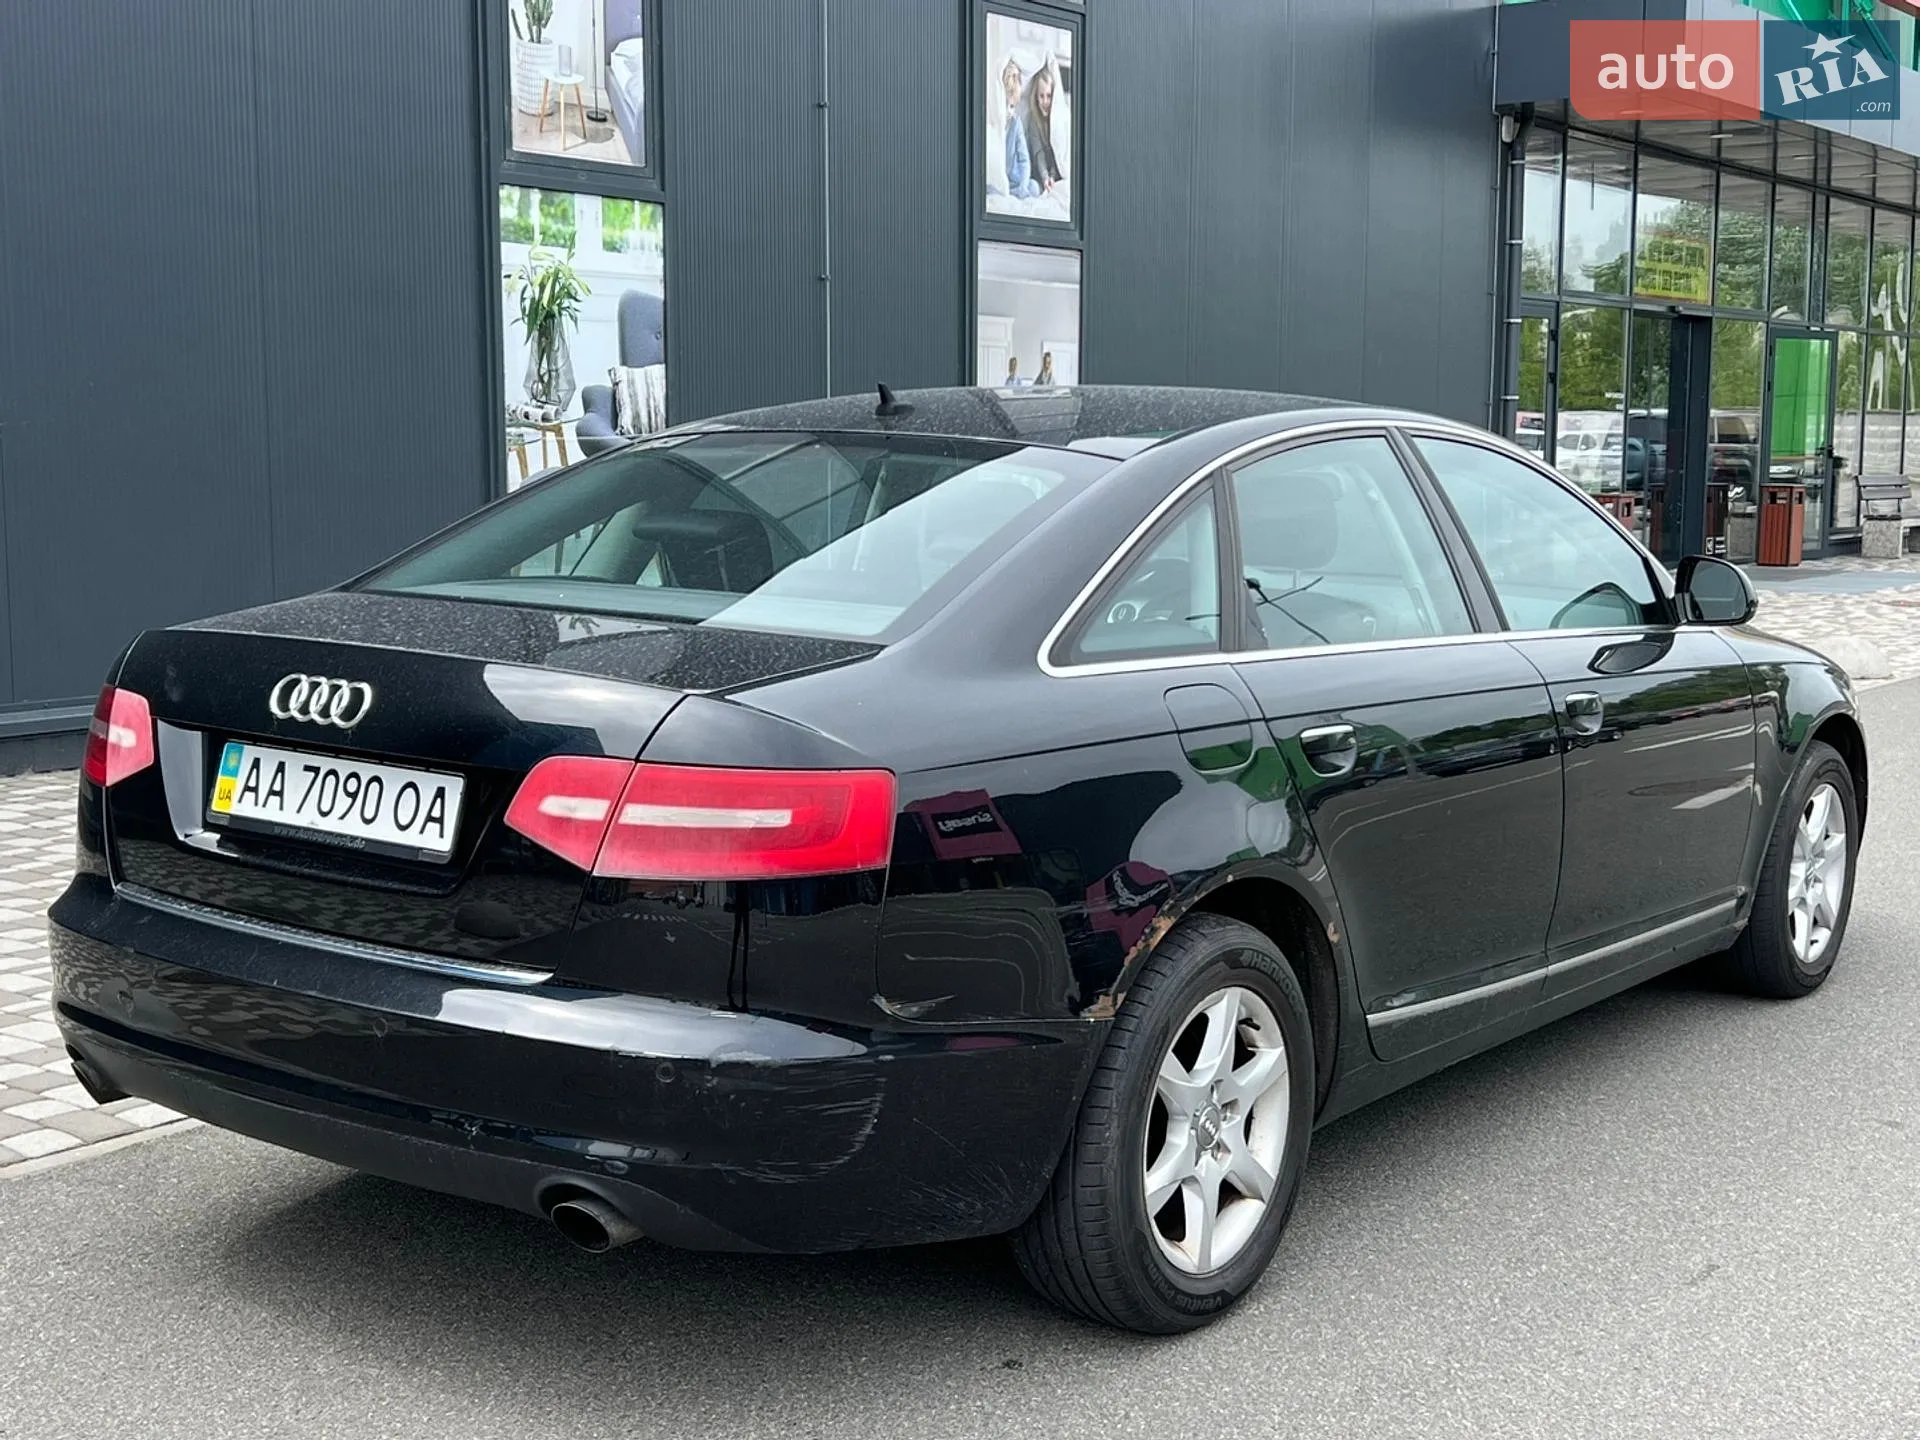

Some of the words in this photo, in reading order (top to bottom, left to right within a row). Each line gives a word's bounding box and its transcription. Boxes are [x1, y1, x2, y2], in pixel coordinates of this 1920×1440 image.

[218, 787, 232, 801] UA
[238, 757, 286, 811] AA
[296, 764, 384, 825] 7090
[394, 781, 446, 838] OA
